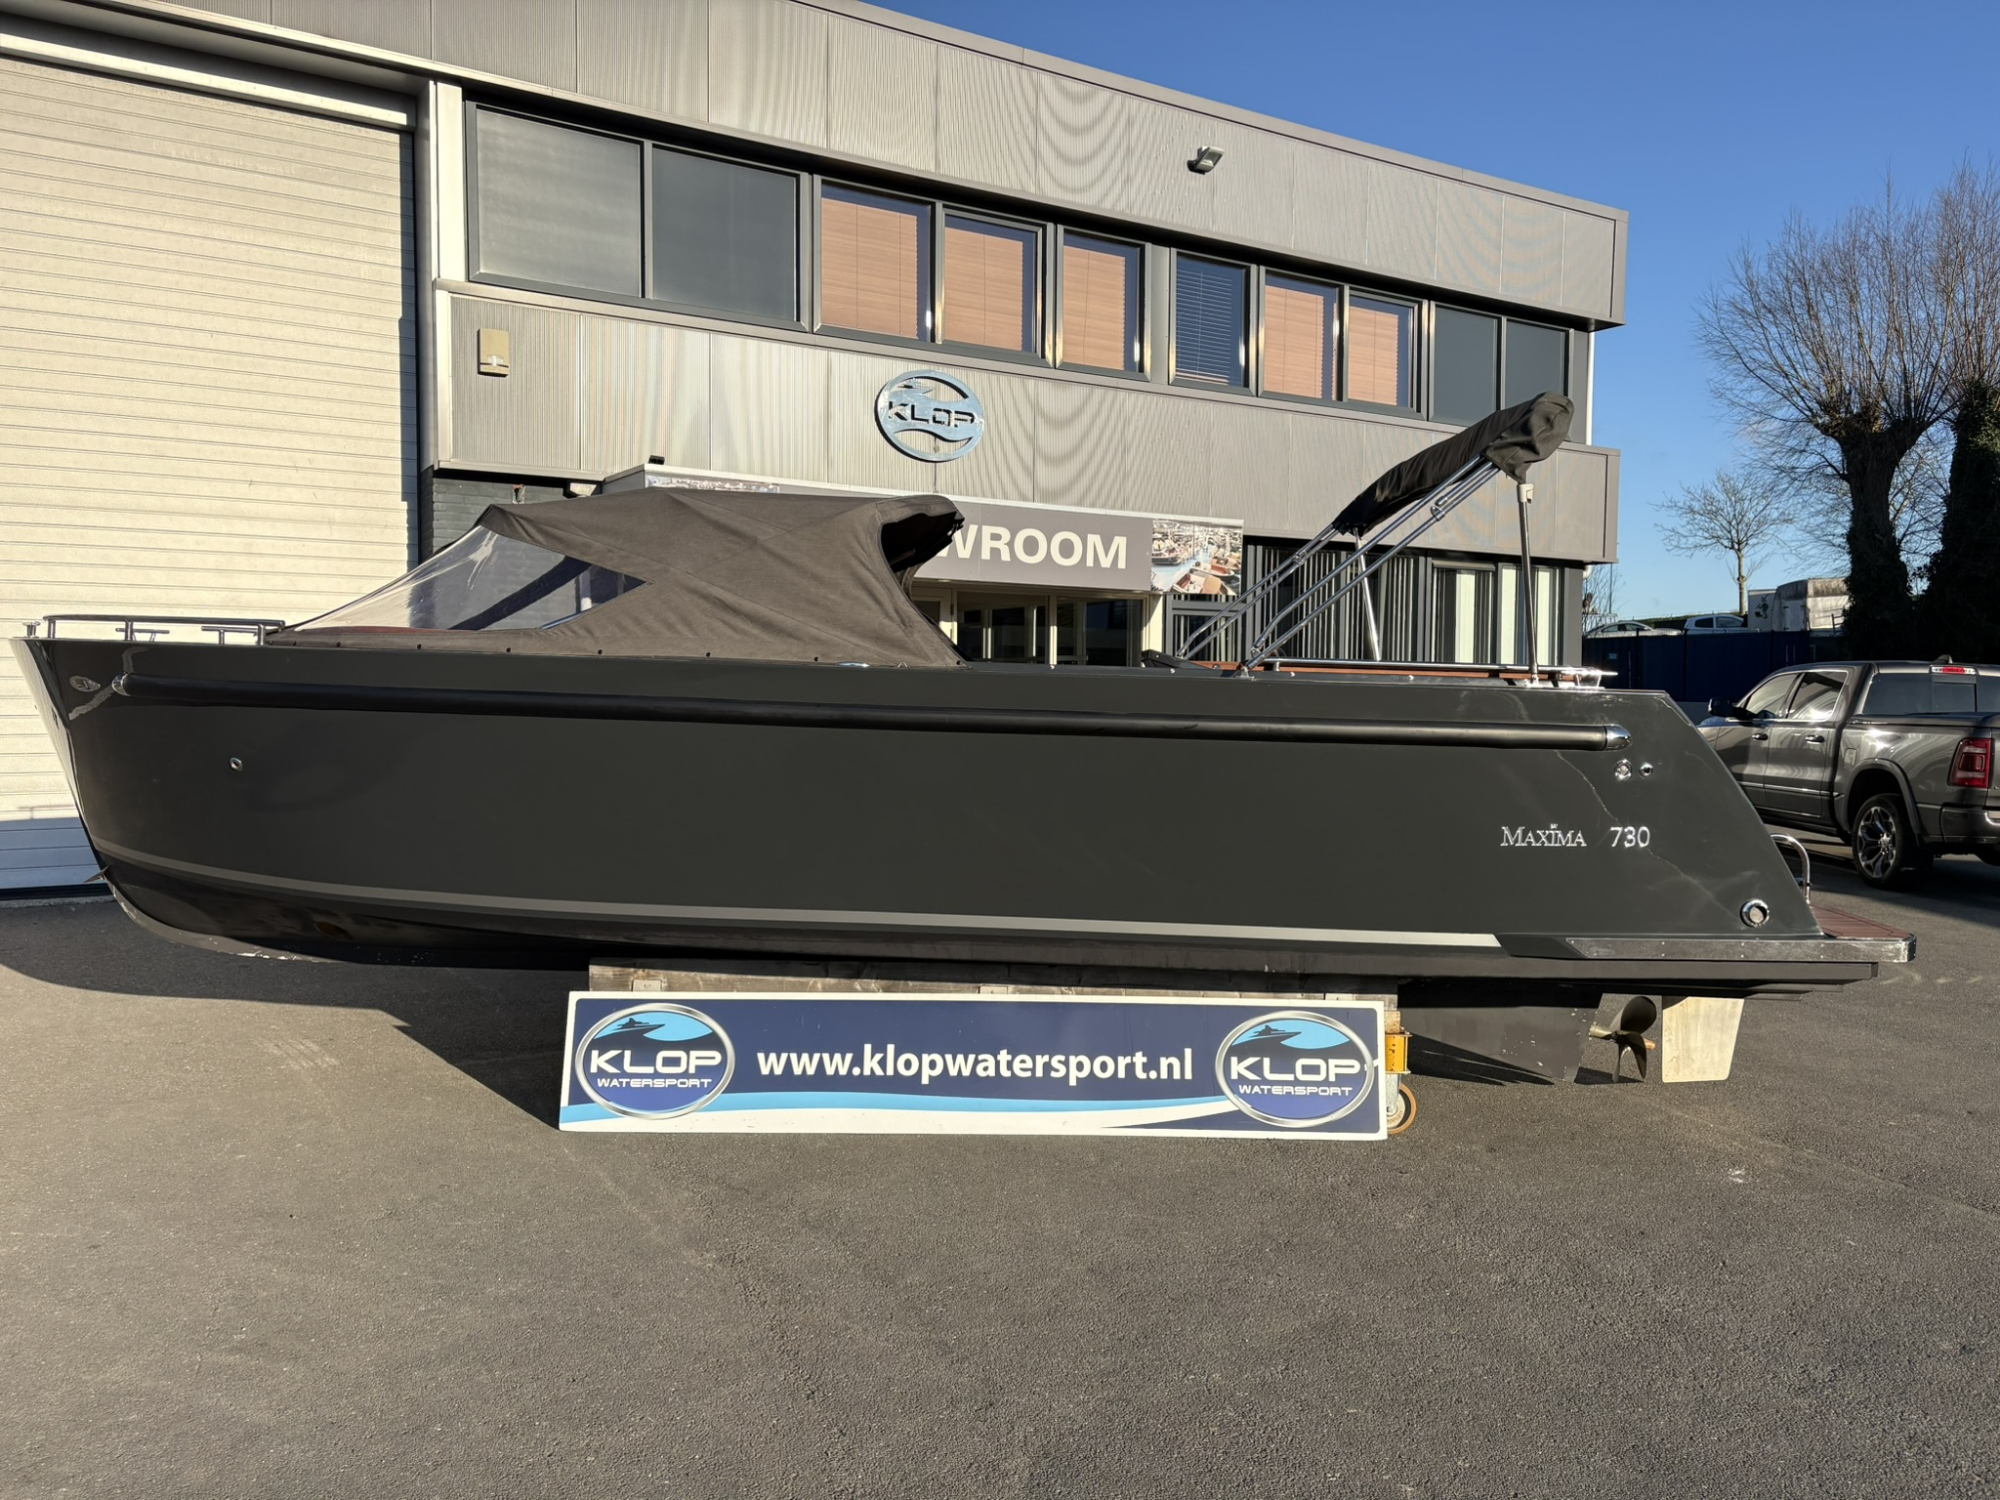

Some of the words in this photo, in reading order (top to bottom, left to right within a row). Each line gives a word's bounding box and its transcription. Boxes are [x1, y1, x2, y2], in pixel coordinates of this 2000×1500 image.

[888, 400, 977, 429] KLOP
[1610, 826, 1651, 848] 730
[590, 1050, 722, 1074] KLOP
[757, 1043, 1193, 1087] www.klopwatersport.nl
[1230, 1056, 1361, 1082] KLOP
[597, 1078, 712, 1088] WATERSPORT
[1238, 1084, 1353, 1097] WATERSPORT
